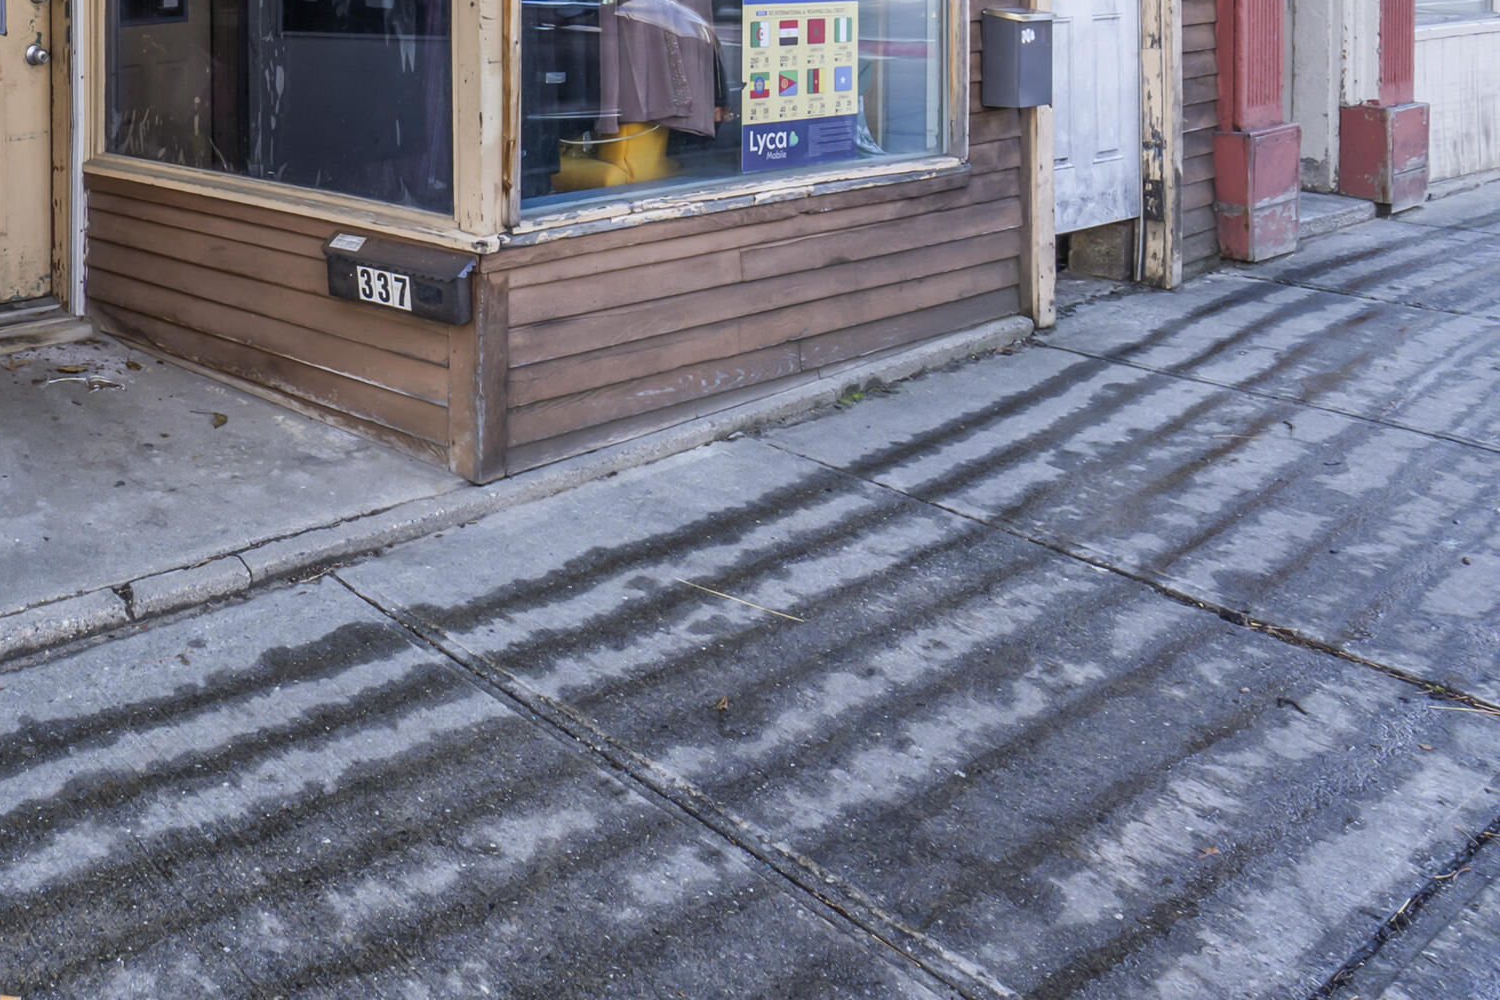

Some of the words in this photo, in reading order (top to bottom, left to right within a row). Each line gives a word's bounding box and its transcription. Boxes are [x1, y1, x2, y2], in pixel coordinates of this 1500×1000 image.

[749, 130, 787, 155] Lyca
[765, 150, 787, 160] Mobile
[360, 268, 408, 307] 337
